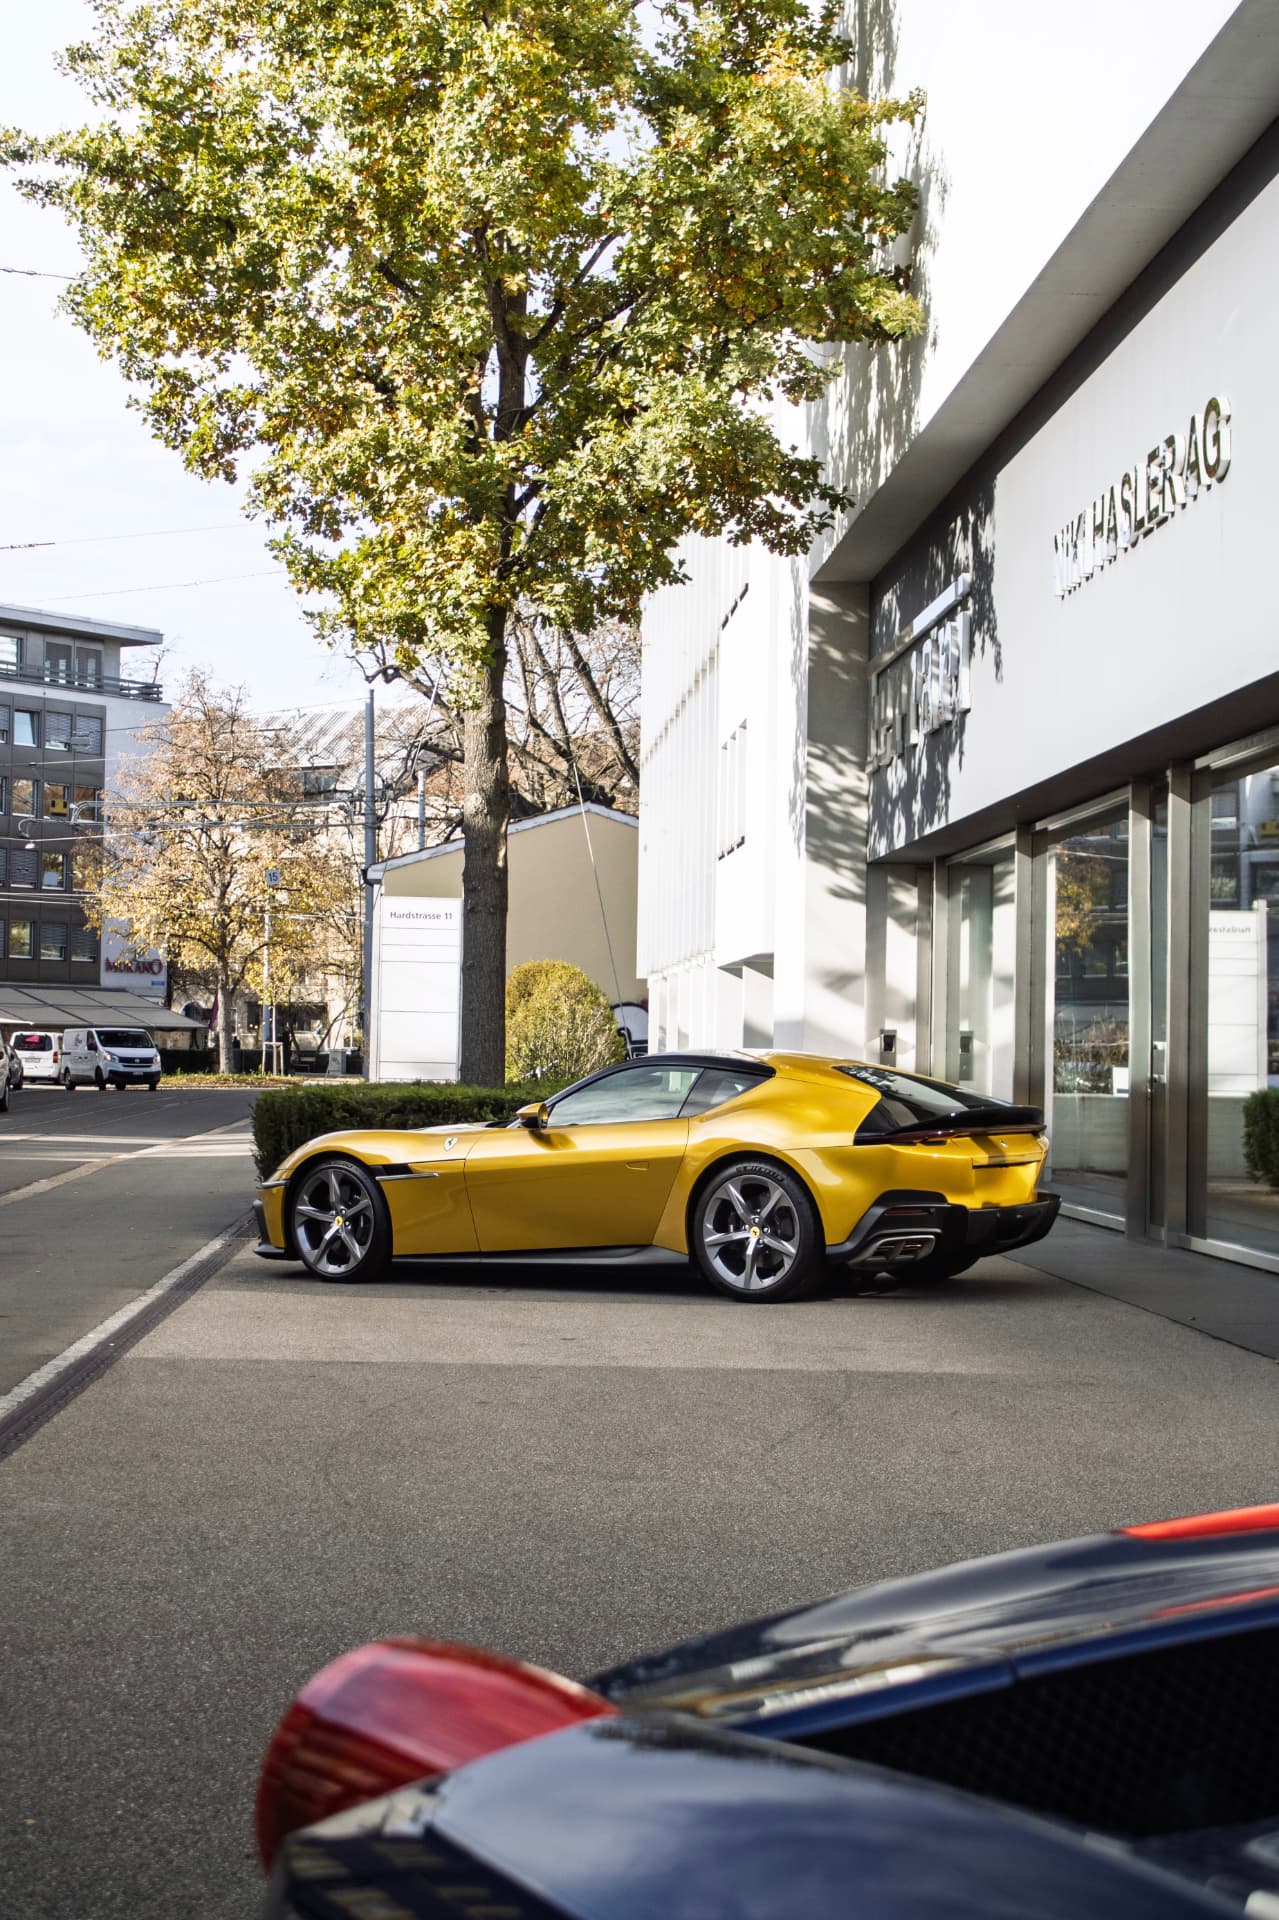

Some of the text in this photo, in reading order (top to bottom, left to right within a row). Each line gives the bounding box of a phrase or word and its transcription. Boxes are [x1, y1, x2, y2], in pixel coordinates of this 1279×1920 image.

[1092, 433, 1188, 570] HASLER
[1184, 396, 1232, 501] AG
[268, 871, 279, 882] 15
[390, 911, 453, 920] Hardstrasse 11
